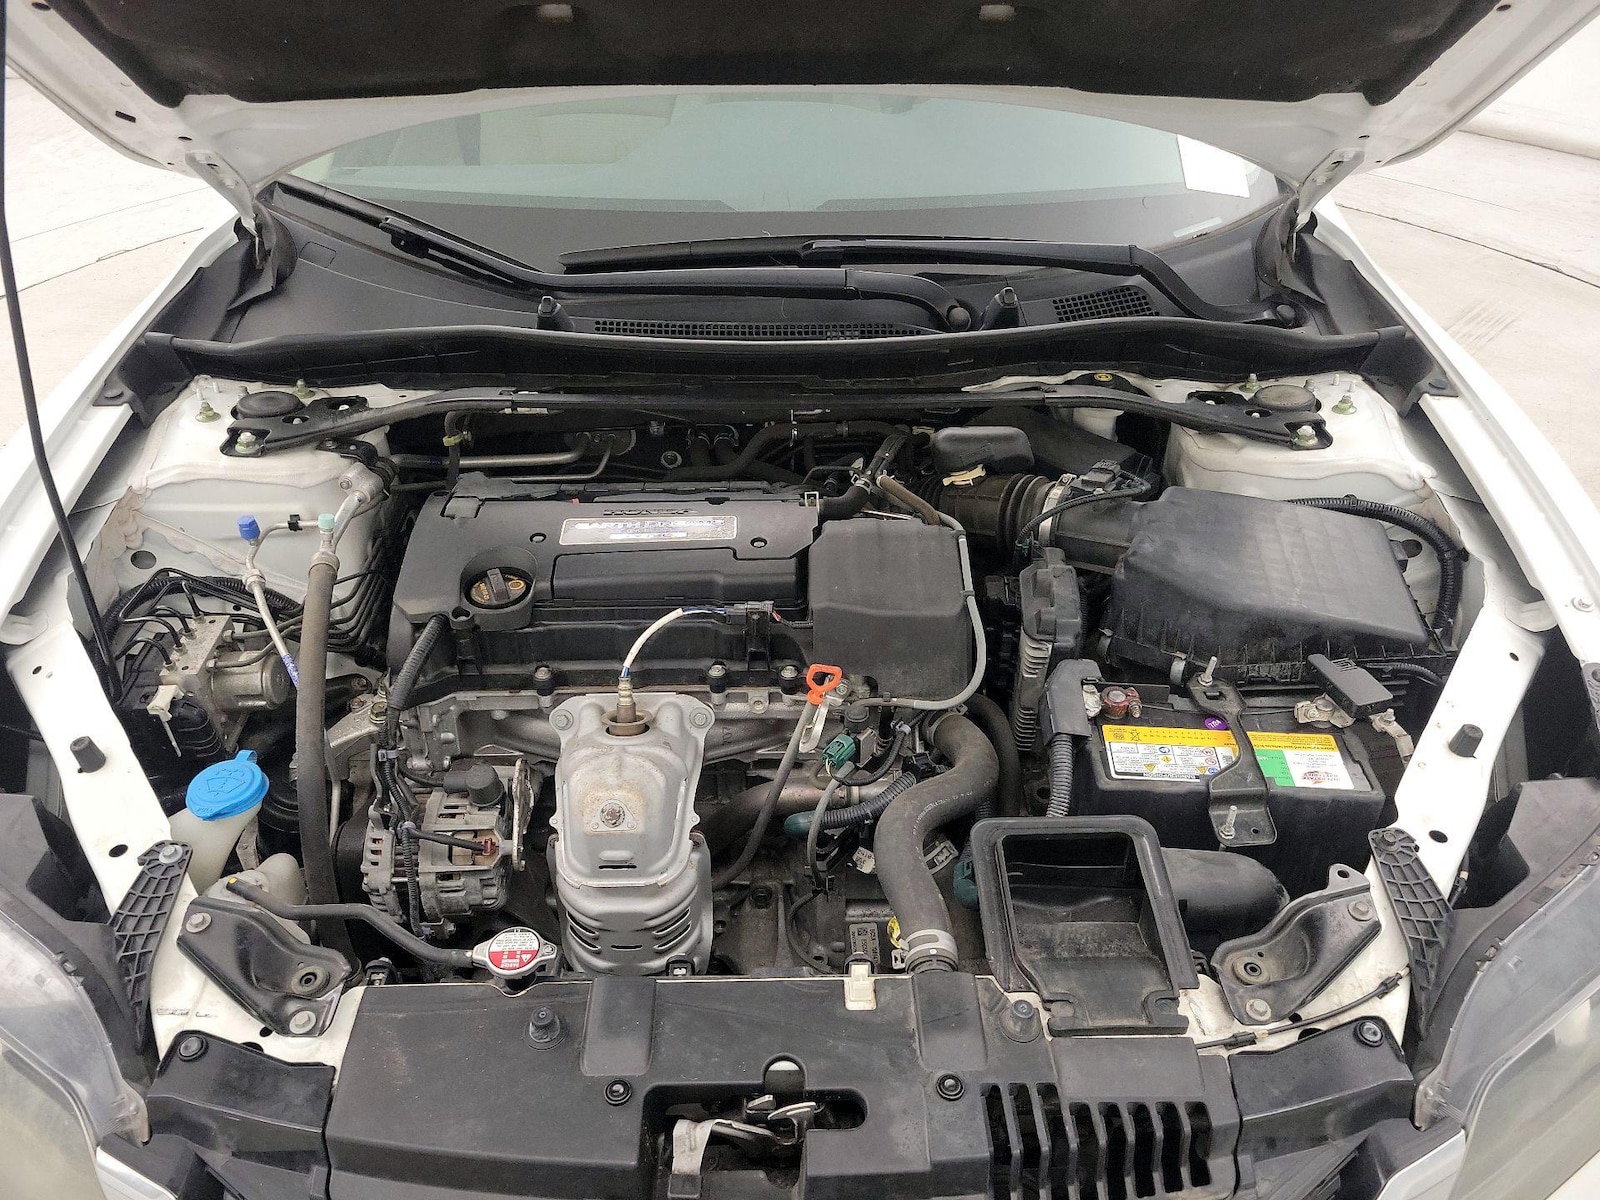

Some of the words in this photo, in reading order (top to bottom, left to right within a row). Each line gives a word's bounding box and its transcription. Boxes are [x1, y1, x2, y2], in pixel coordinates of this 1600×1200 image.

[603, 508, 697, 516] HONDA
[574, 522, 641, 530] EARTH
[644, 519, 725, 529] DREAMS
